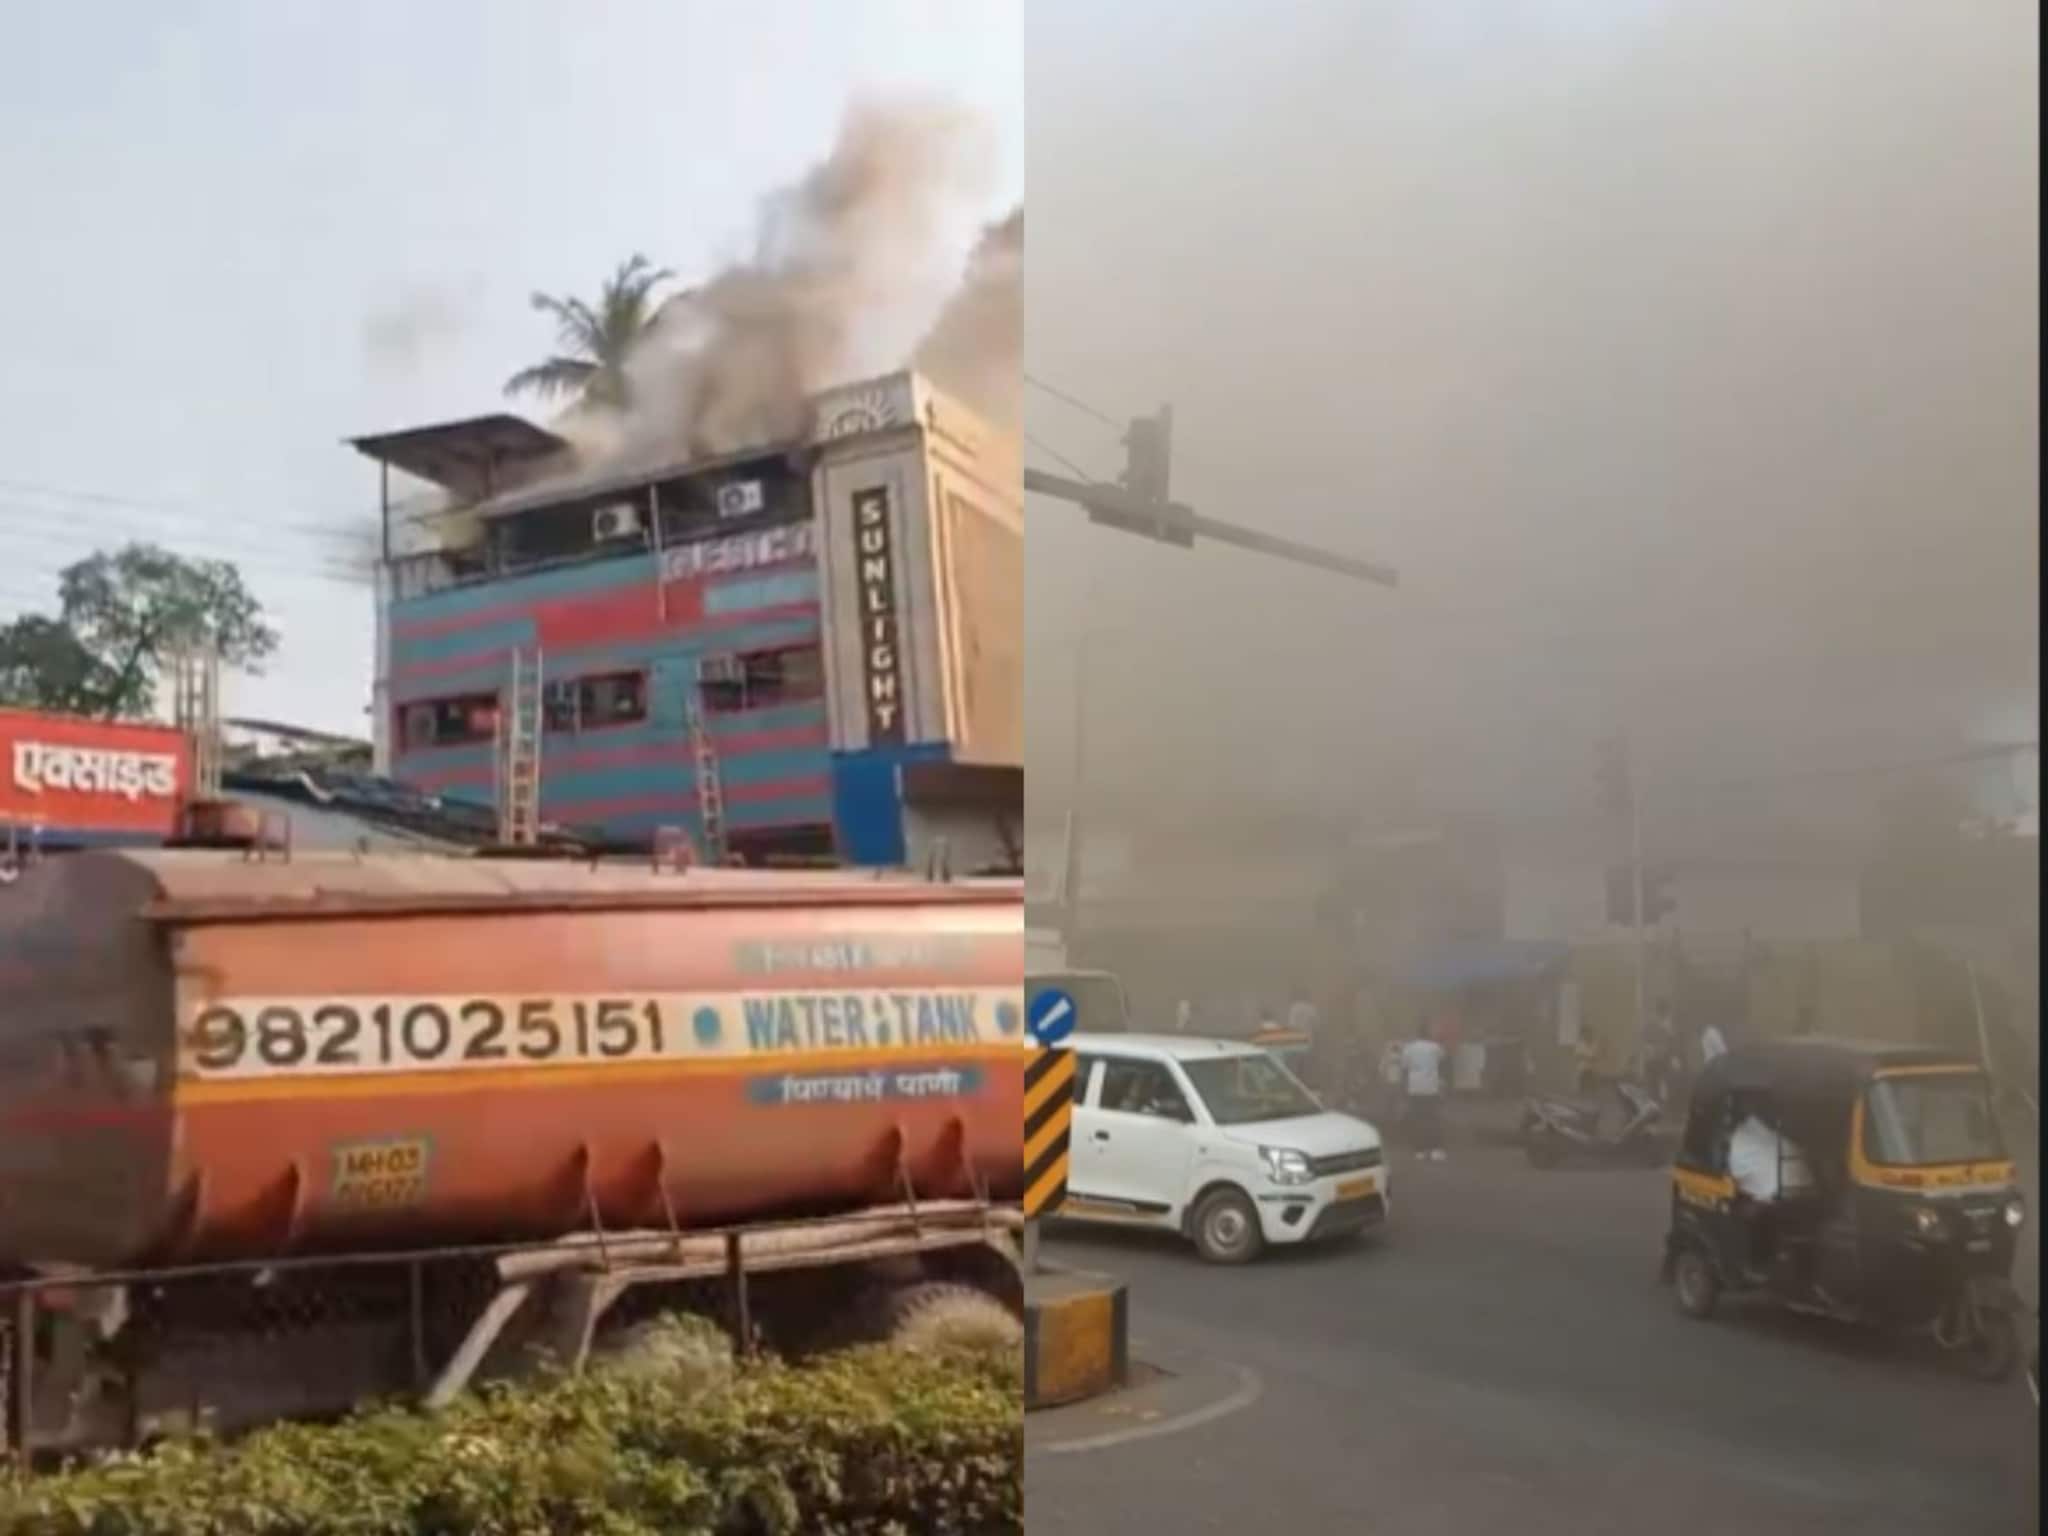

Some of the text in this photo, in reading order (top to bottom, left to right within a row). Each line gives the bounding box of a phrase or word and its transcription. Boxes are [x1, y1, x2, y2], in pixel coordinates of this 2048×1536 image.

[861, 501, 895, 729] SUNLIGHT
[192, 1000, 664, 1069] 9821025151
[744, 994, 980, 1049] WATER TANK
